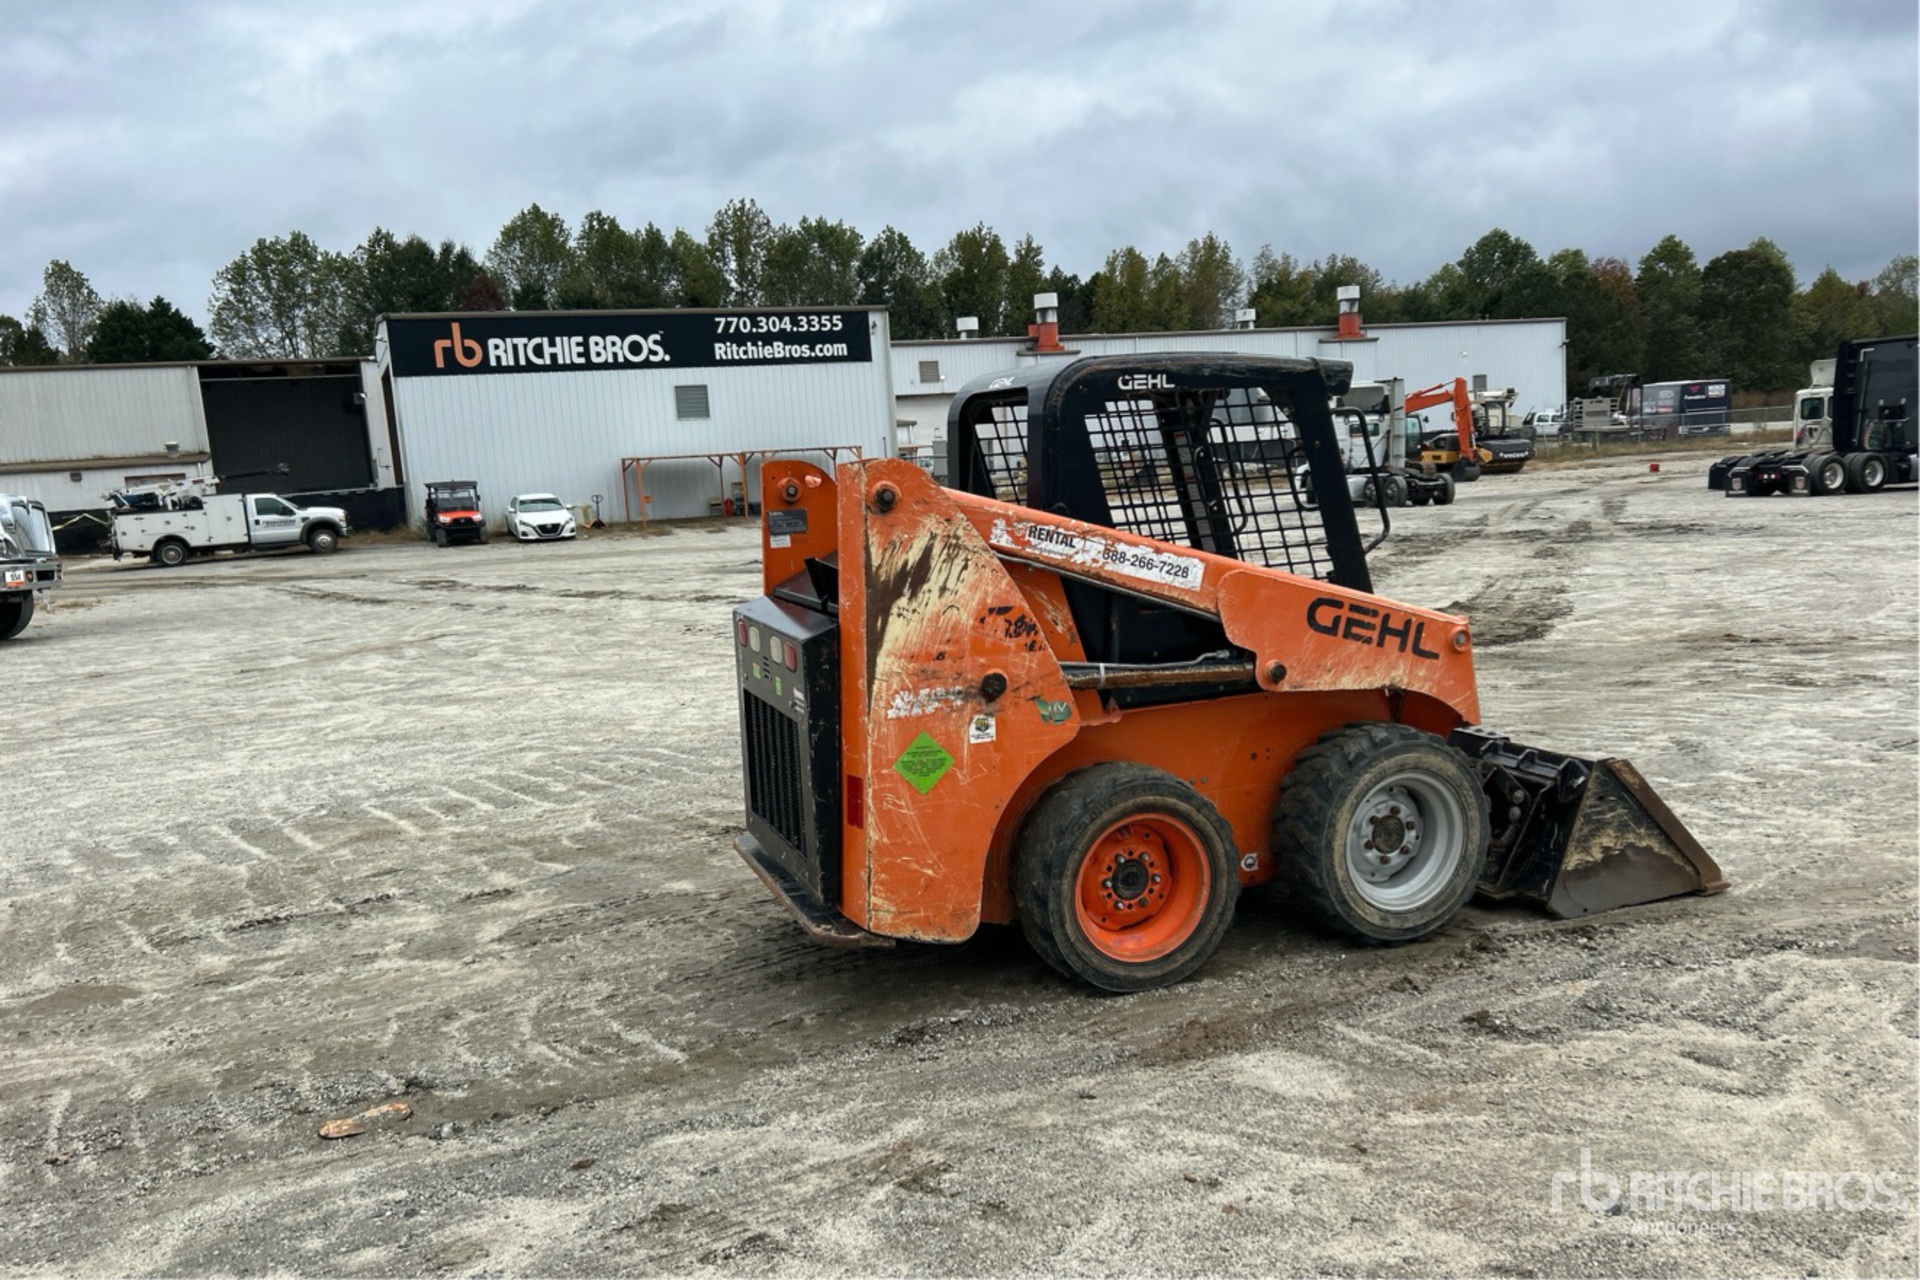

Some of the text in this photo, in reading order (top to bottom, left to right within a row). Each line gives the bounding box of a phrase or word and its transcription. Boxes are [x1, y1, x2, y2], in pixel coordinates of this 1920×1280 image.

[714, 315, 843, 334] 770.304.3355
[487, 336, 586, 367] RITCHIE
[588, 333, 671, 363] BROS.
[714, 341, 848, 360] RitchieBros.com
[1117, 374, 1175, 390] GEHL
[1028, 525, 1076, 548] RENTAL
[1306, 597, 1440, 660] GEHL
